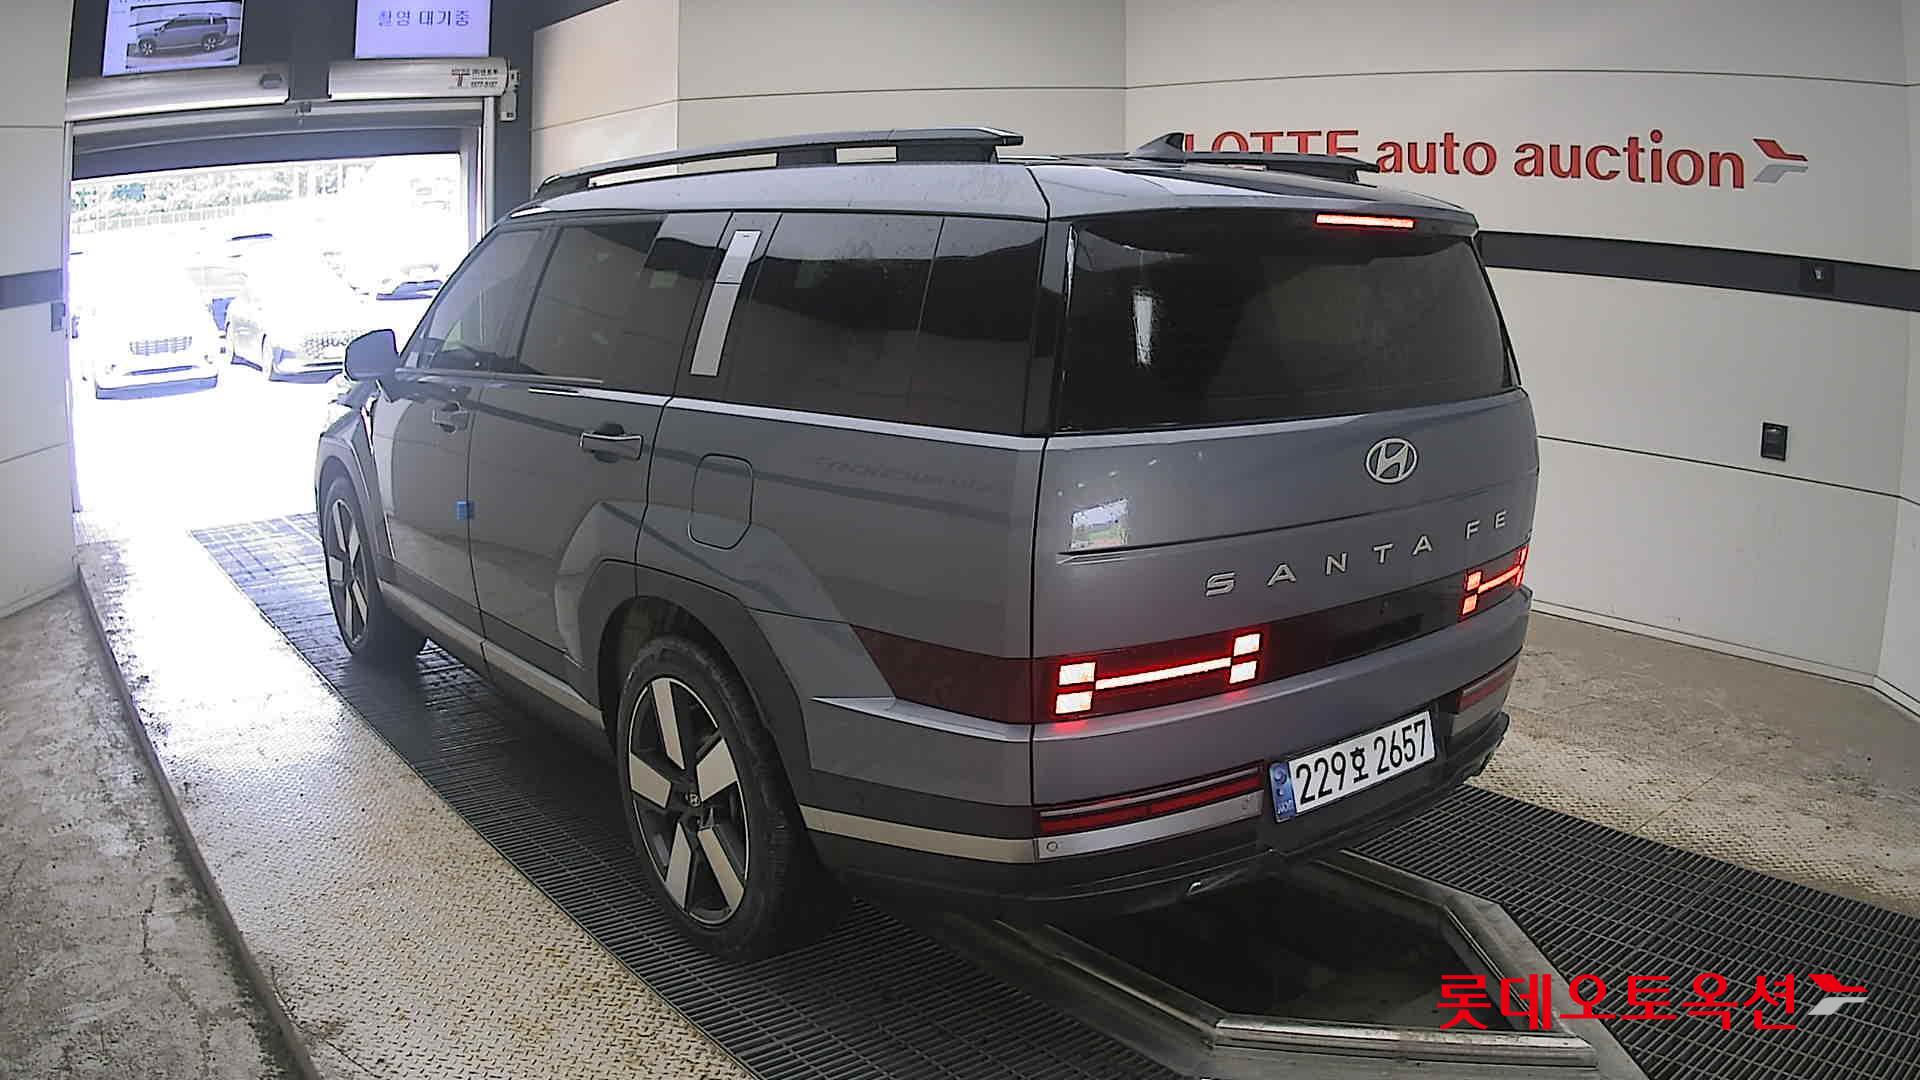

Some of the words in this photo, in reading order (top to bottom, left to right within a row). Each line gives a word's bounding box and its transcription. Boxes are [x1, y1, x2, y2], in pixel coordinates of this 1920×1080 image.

[419, 9, 472, 27] 대기중
[1377, 133, 1497, 175] auto
[1513, 128, 1745, 189] auction
[1206, 535, 1433, 597] SANTA
[1465, 509, 1508, 540] FE
[1372, 721, 1428, 775] 2657
